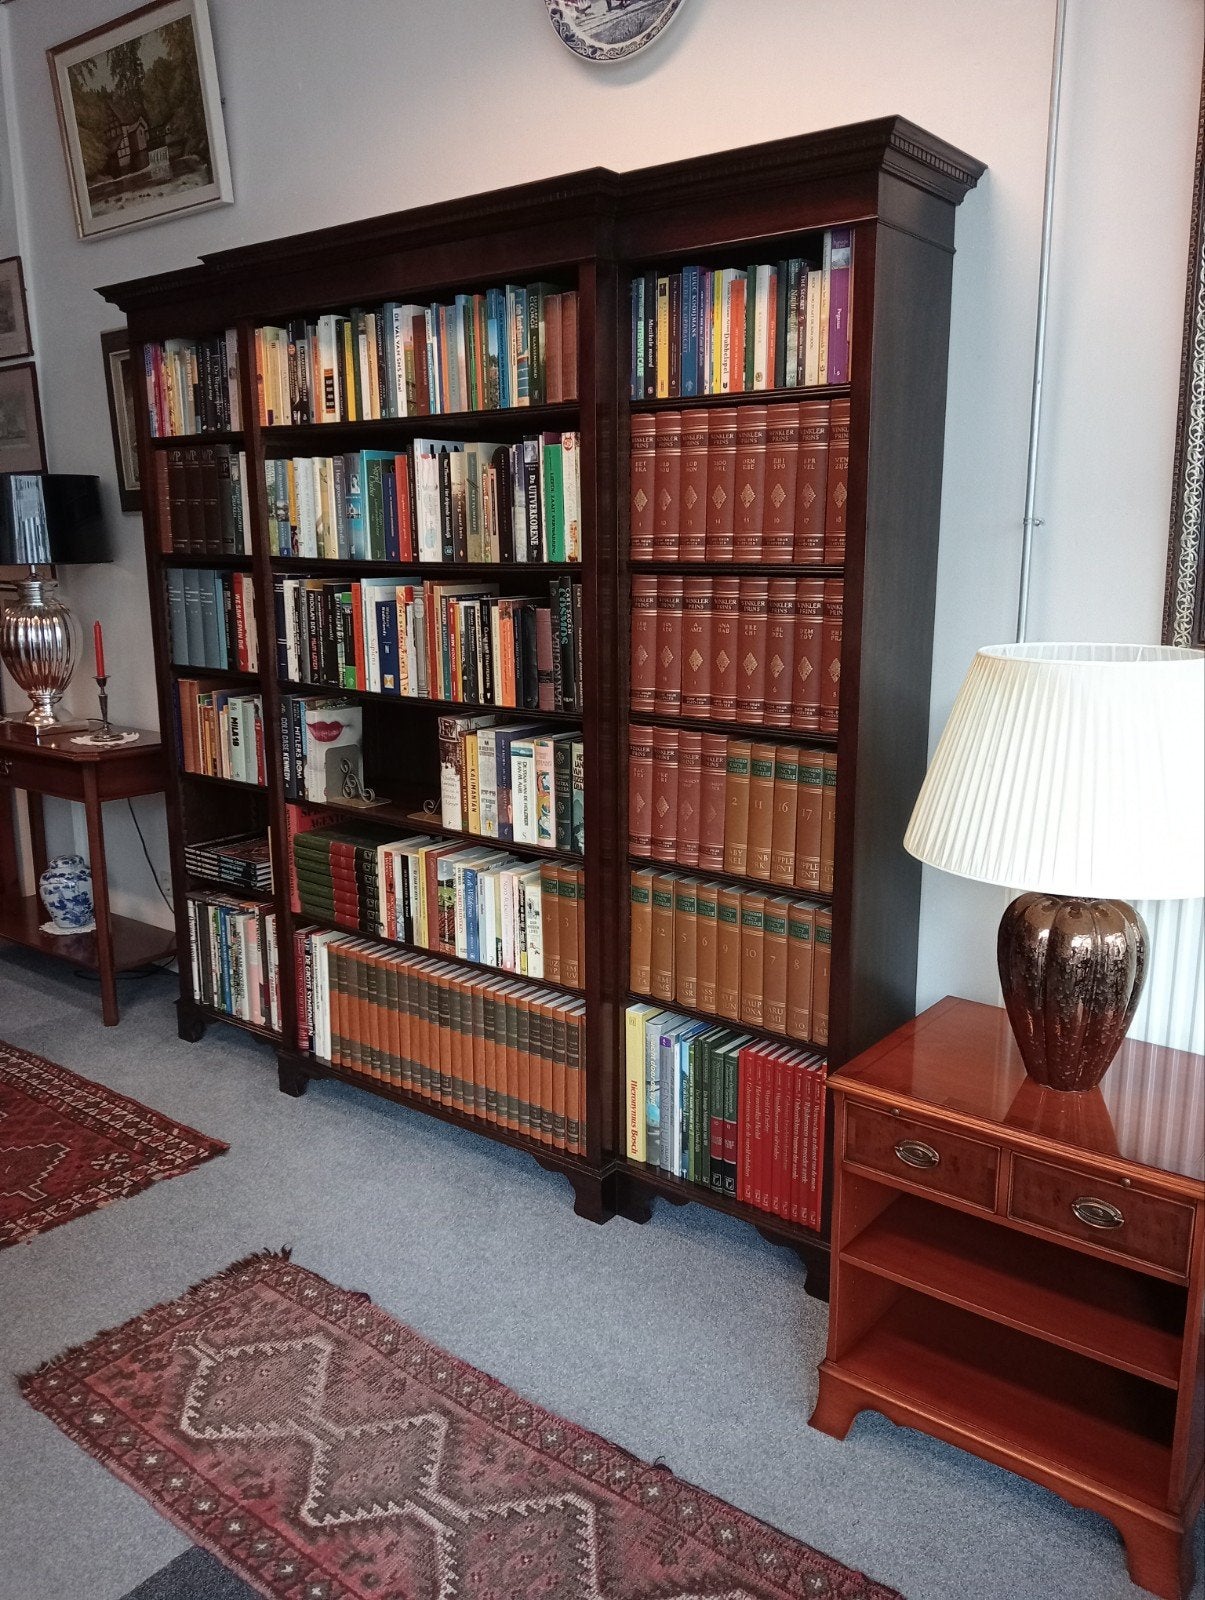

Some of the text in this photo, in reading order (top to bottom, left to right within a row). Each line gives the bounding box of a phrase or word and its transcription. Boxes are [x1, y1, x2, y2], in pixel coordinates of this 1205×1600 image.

[394, 313, 399, 322] DE
[528, 485, 538, 545] UITVERKORENE
[231, 717, 239, 746] MILA 18
